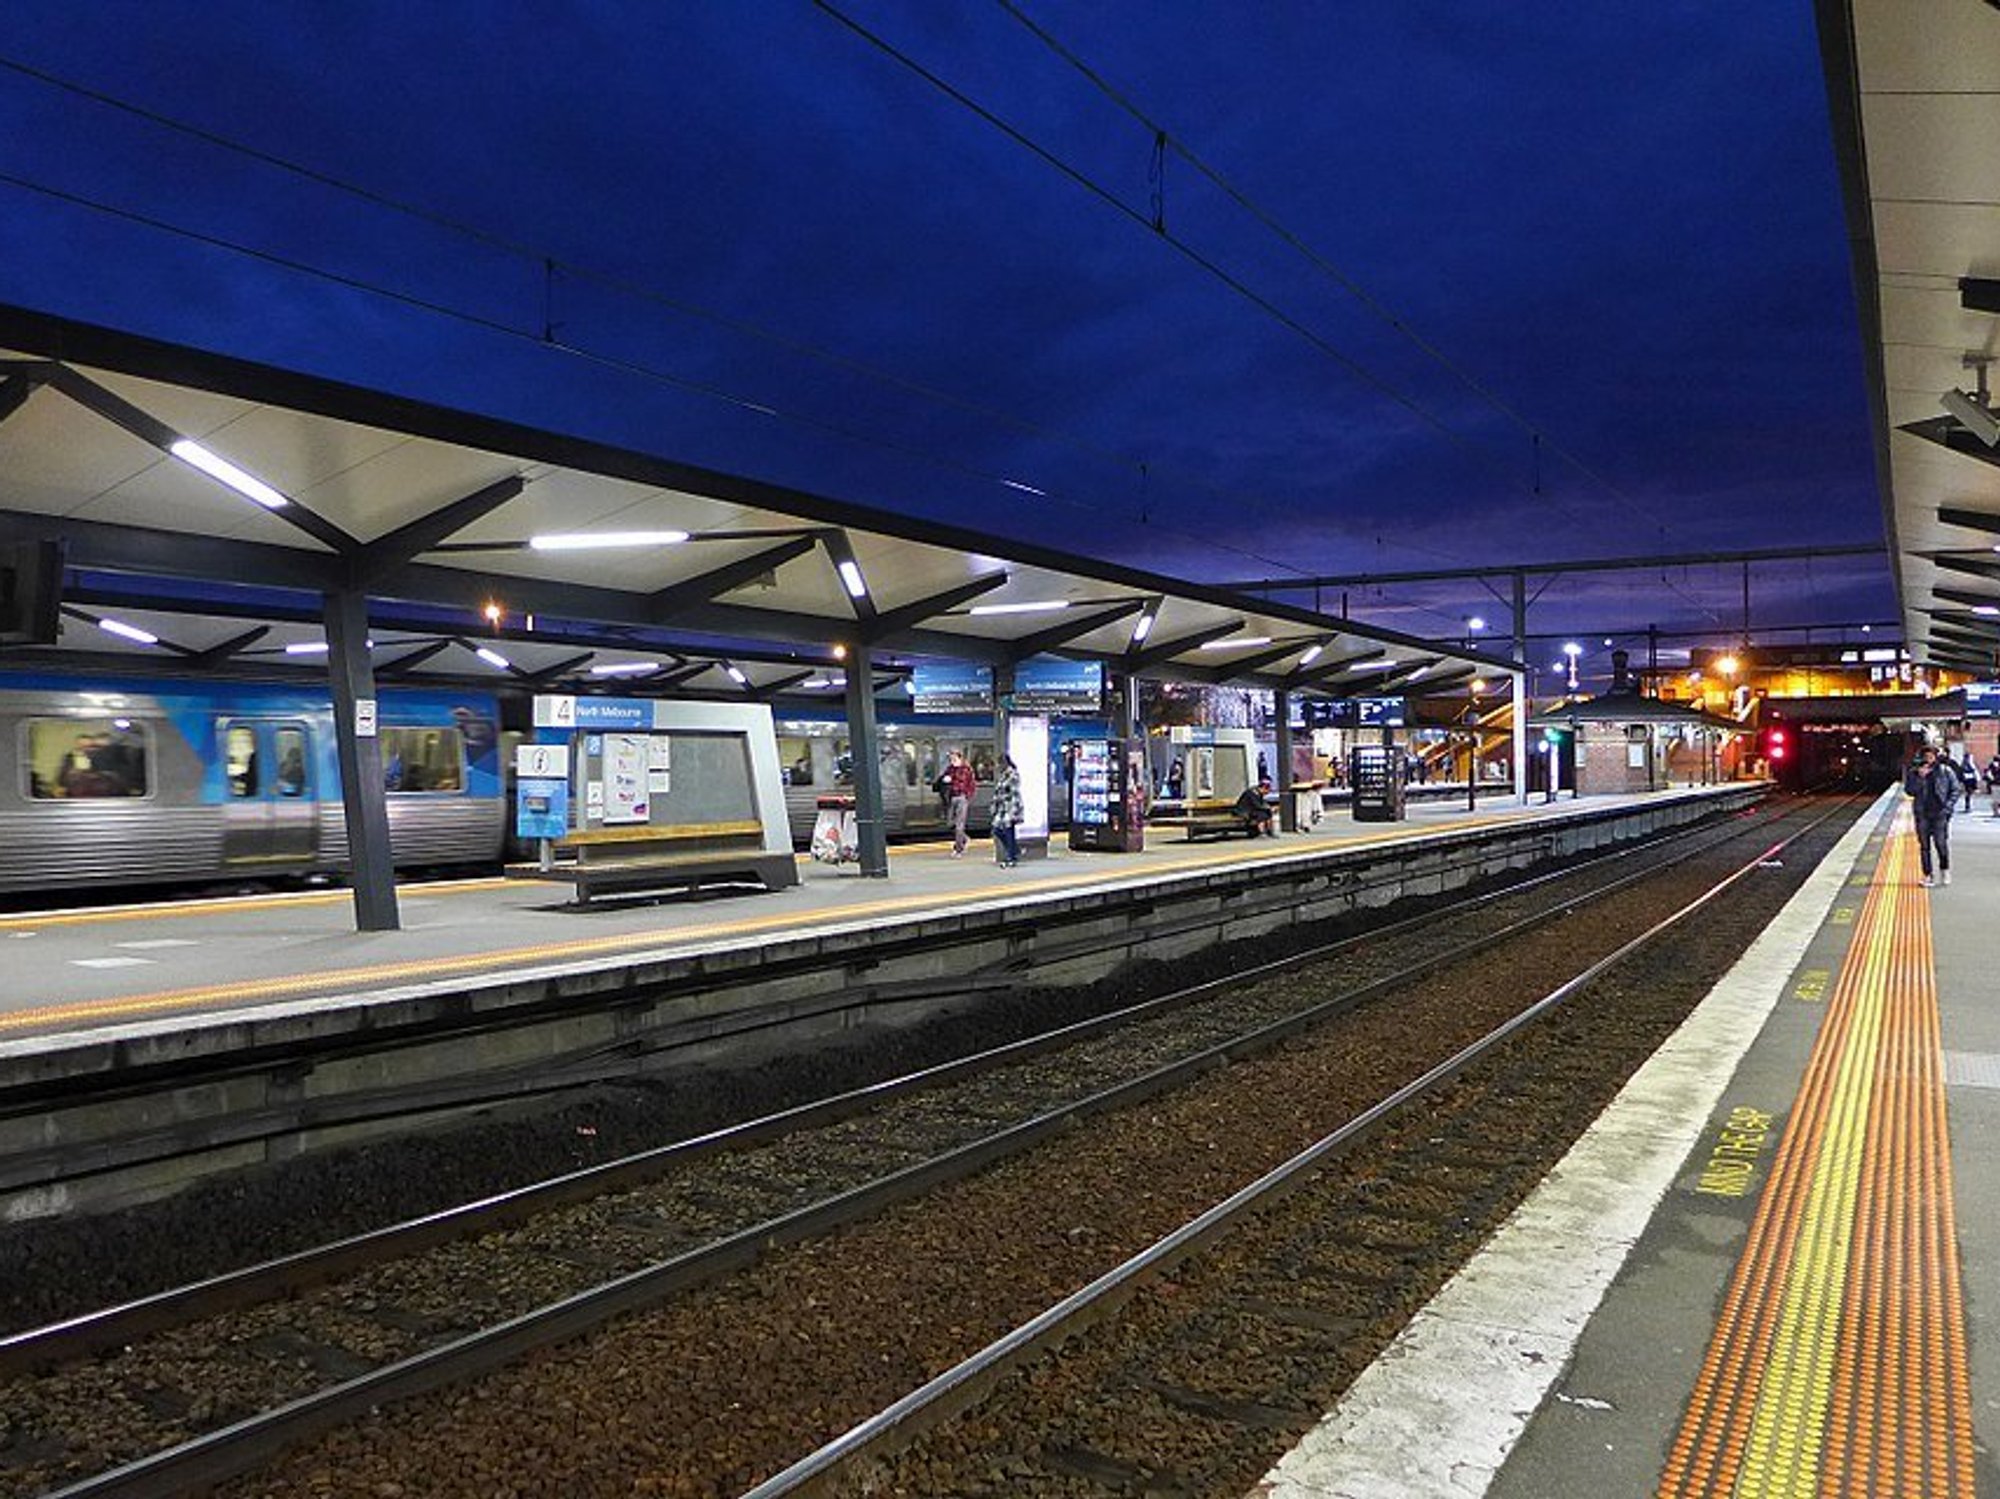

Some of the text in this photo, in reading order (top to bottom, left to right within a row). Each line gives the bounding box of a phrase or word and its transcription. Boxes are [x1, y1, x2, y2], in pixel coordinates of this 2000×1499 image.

[576, 705, 641, 717] North Melbourne
[1694, 1106, 1772, 1197] MIND THE GAP
